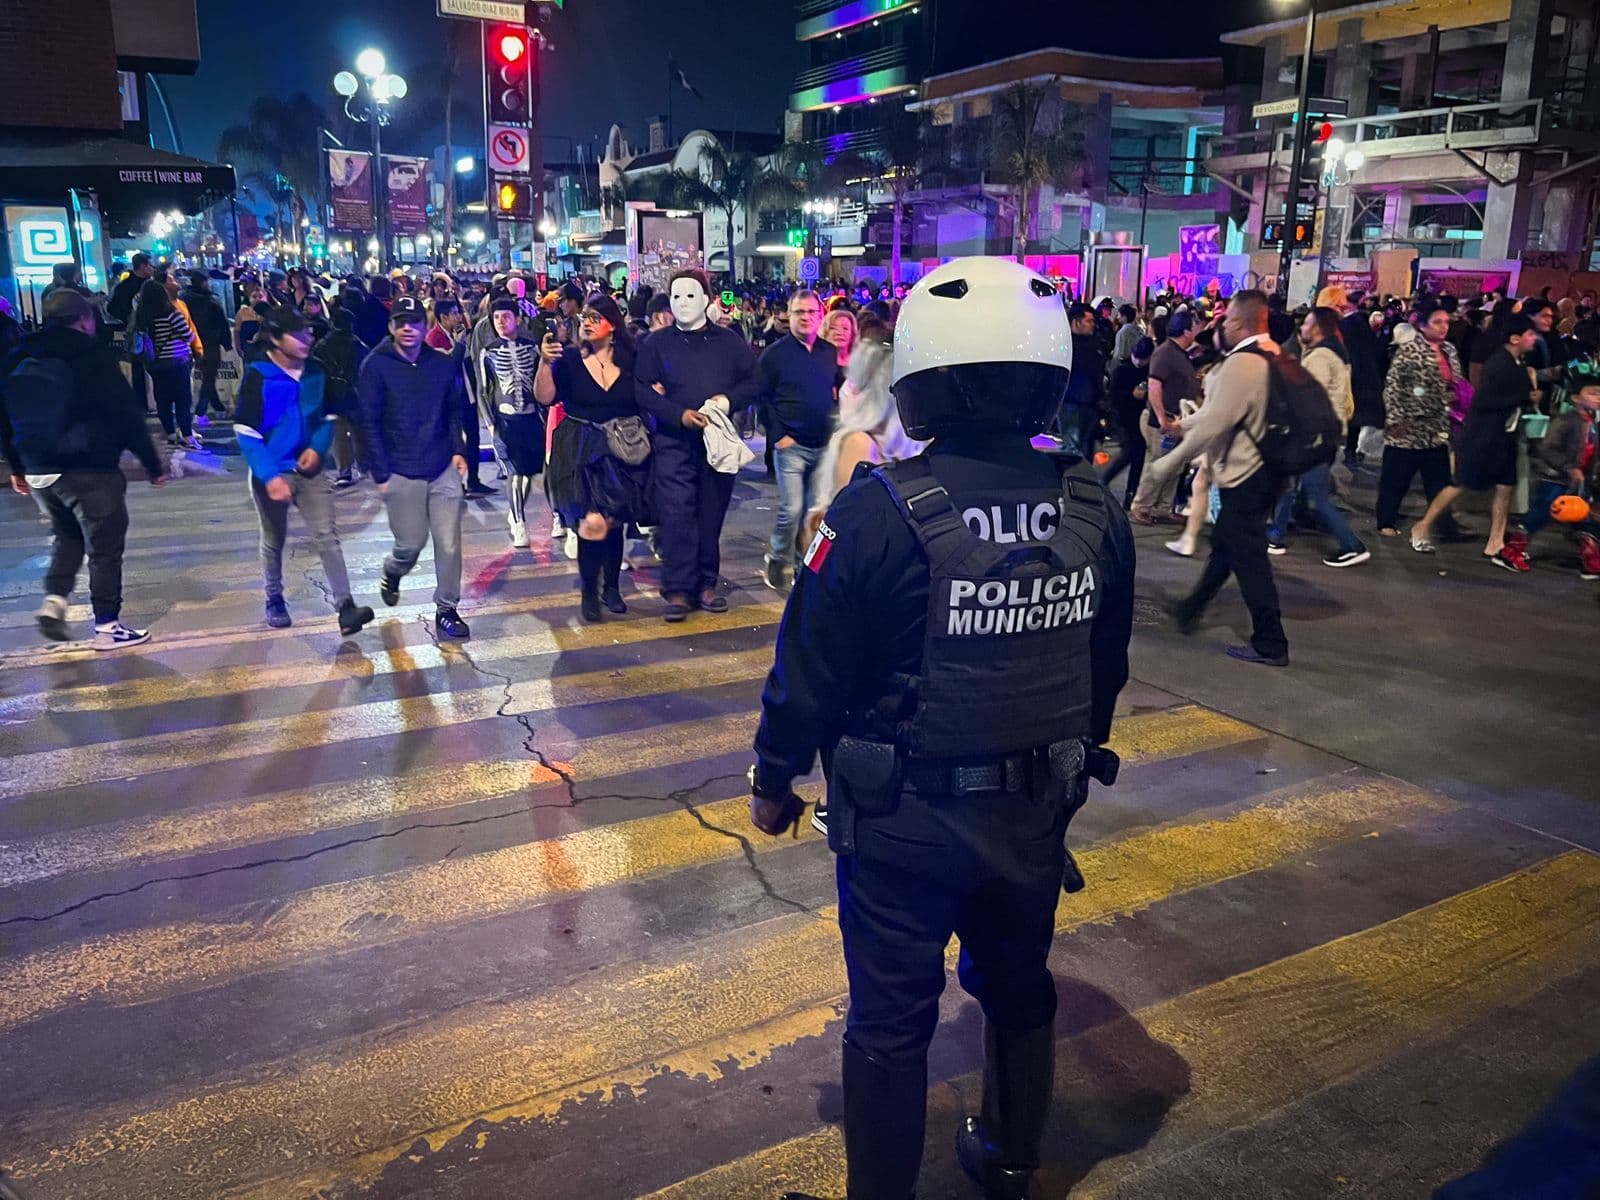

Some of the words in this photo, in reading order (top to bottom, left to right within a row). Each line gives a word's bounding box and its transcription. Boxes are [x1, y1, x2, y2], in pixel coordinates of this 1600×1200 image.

[119, 170, 152, 182] COFFEE
[159, 171, 182, 183] WINE
[184, 172, 203, 183] BAR
[962, 500, 1064, 543] OLIC
[949, 566, 1095, 607] POLICIA
[948, 595, 1094, 635] MUNICIPAL
